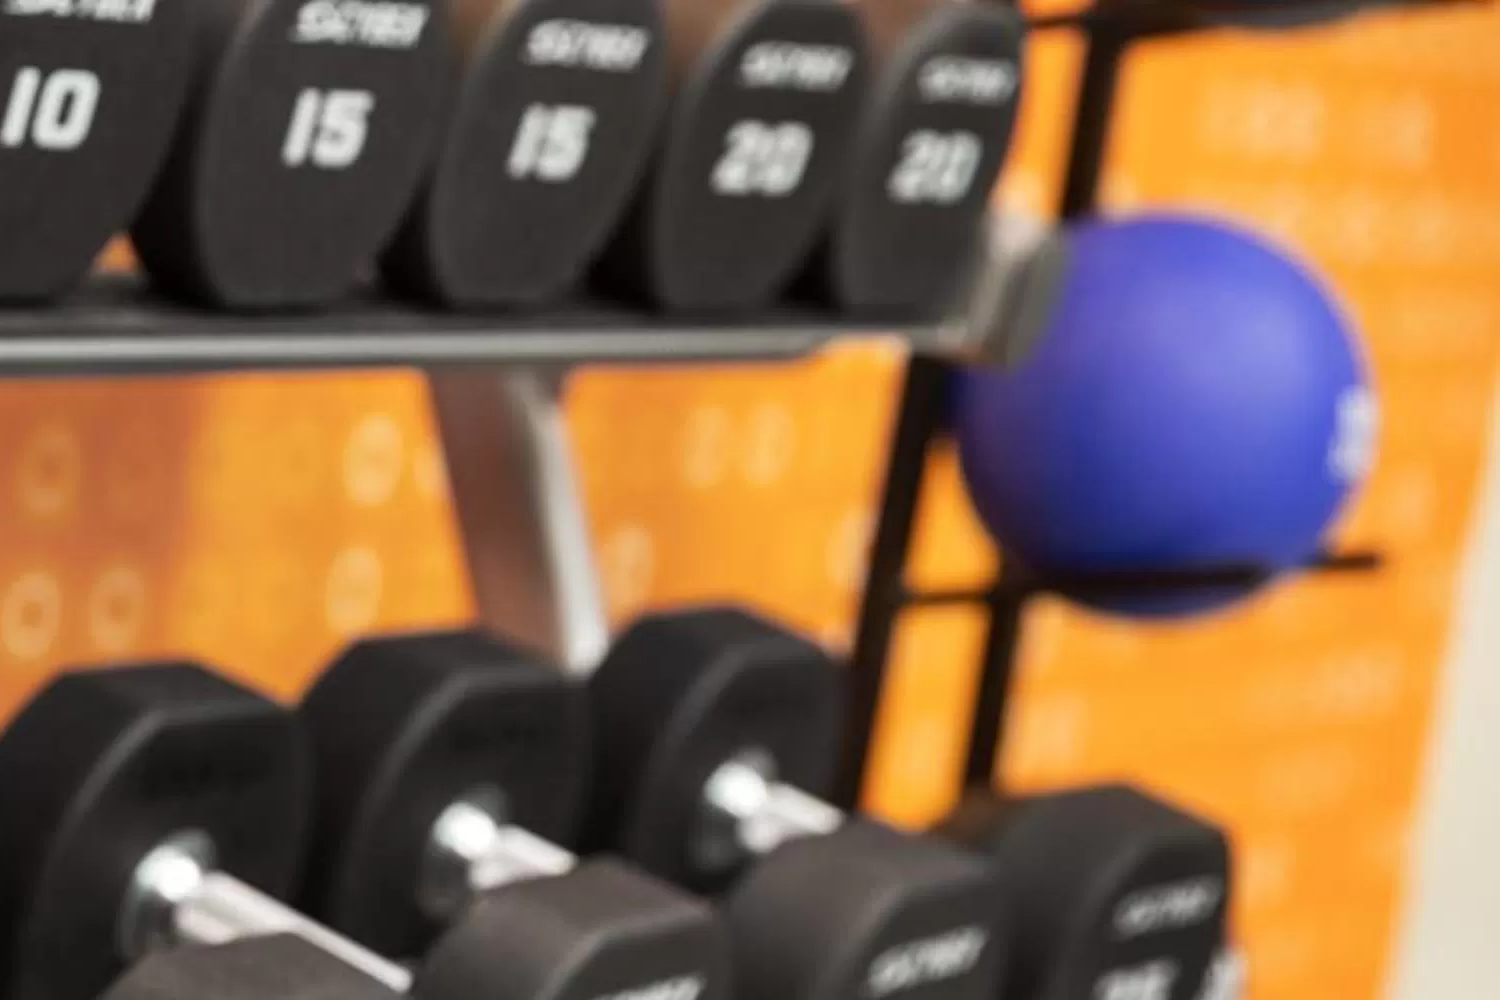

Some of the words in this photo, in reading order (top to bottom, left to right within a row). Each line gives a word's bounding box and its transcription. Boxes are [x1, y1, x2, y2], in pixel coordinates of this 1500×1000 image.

[0, 67, 100, 149] 10
[283, 87, 374, 167] 15
[508, 104, 594, 181] 15
